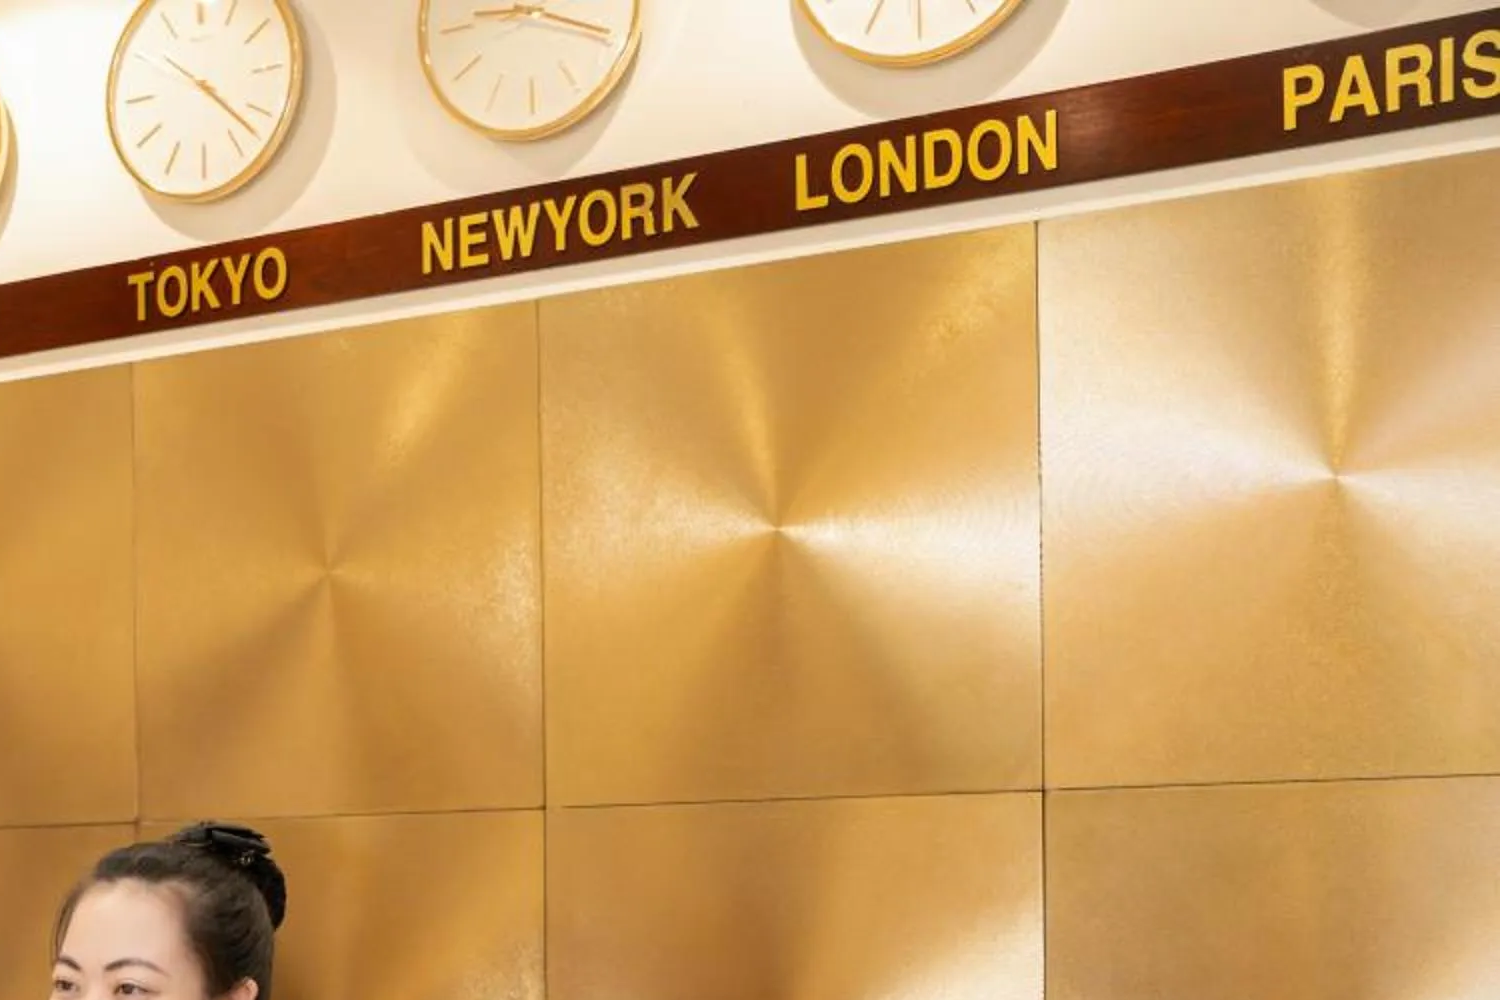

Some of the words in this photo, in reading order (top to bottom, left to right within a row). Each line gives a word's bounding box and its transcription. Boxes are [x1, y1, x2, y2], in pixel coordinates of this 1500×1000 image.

[1283, 29, 1500, 132] PARIS
[795, 109, 1058, 212] LONDON
[421, 172, 701, 275] NEWYORK
[128, 246, 288, 321] TOKYO
